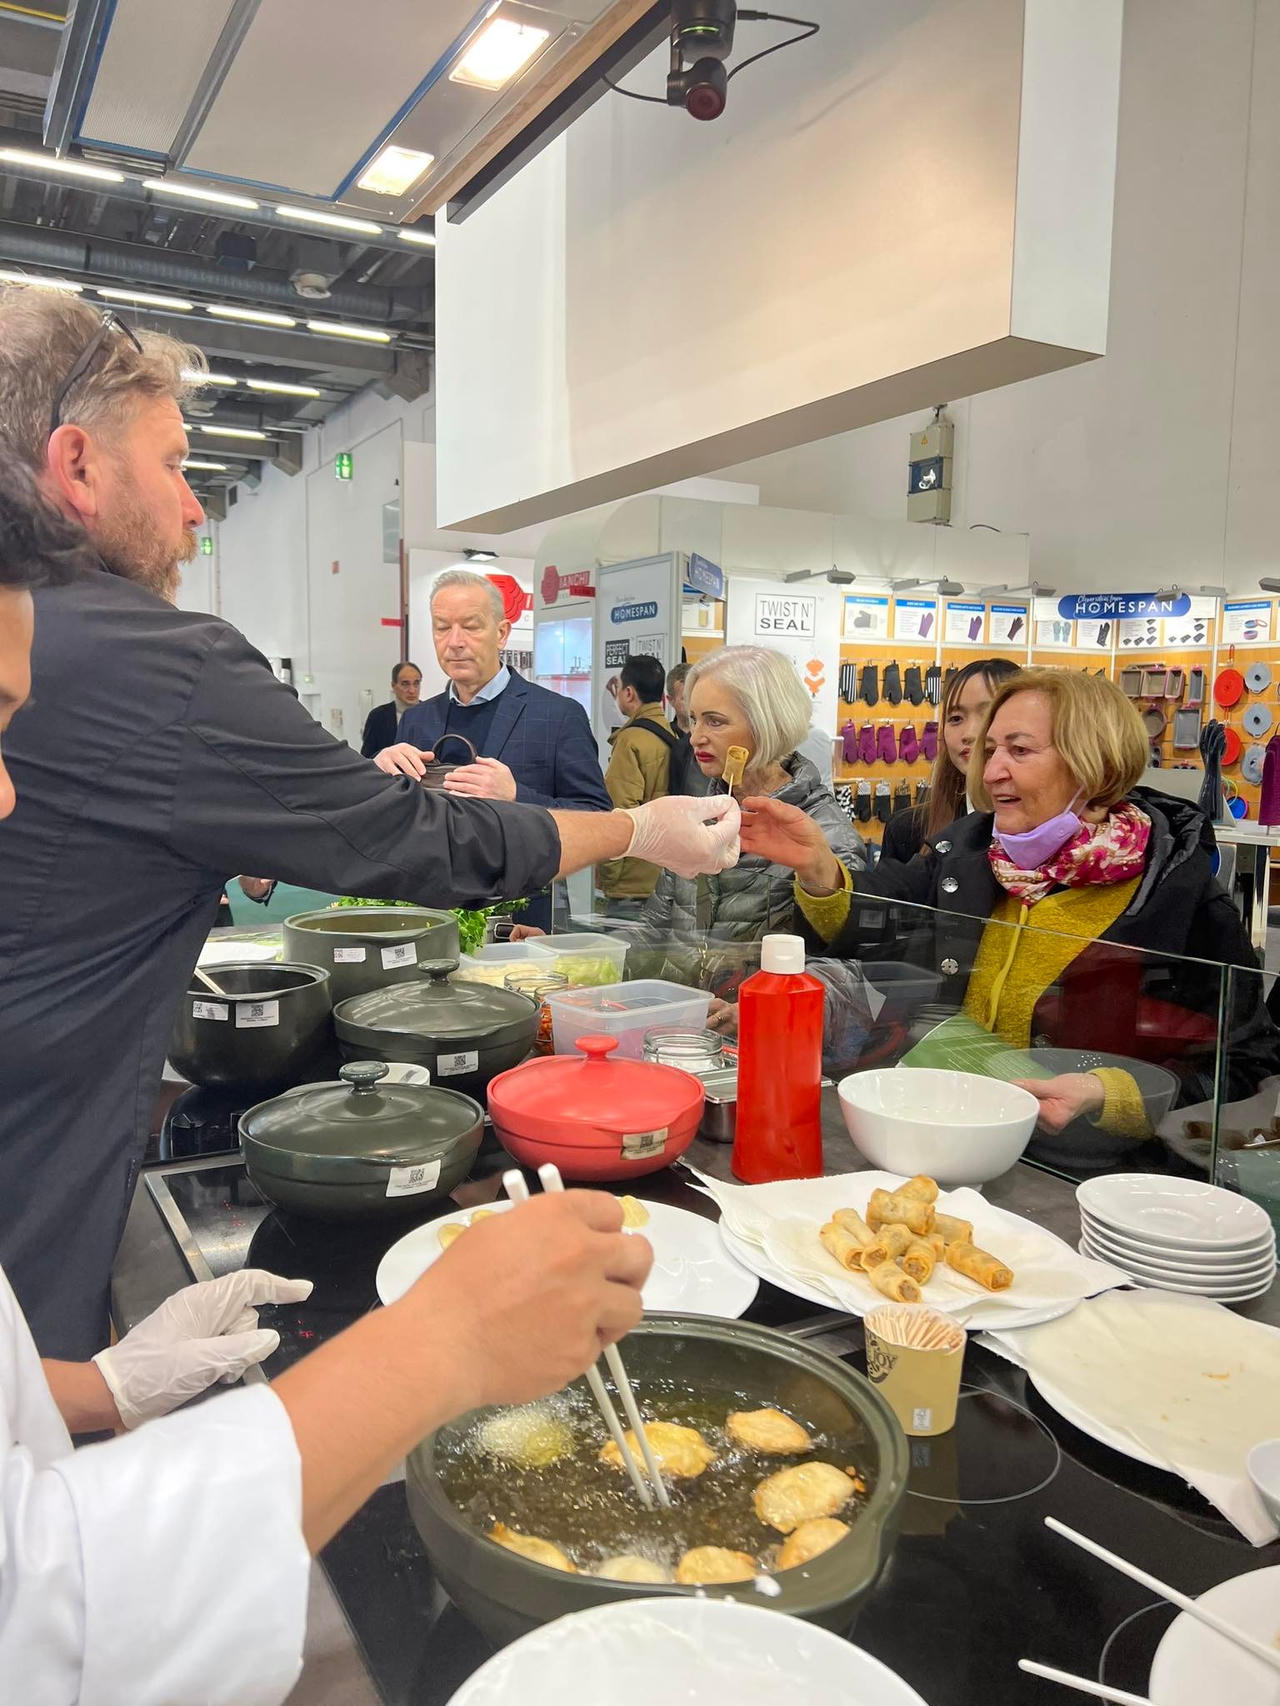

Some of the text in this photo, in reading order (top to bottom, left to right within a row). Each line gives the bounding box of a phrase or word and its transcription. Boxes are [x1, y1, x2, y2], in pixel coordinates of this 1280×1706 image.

[614, 604, 655, 619] HOMESPAN
[1075, 601, 1173, 614] HOMESPAN
[760, 617, 810, 631] SEAL
